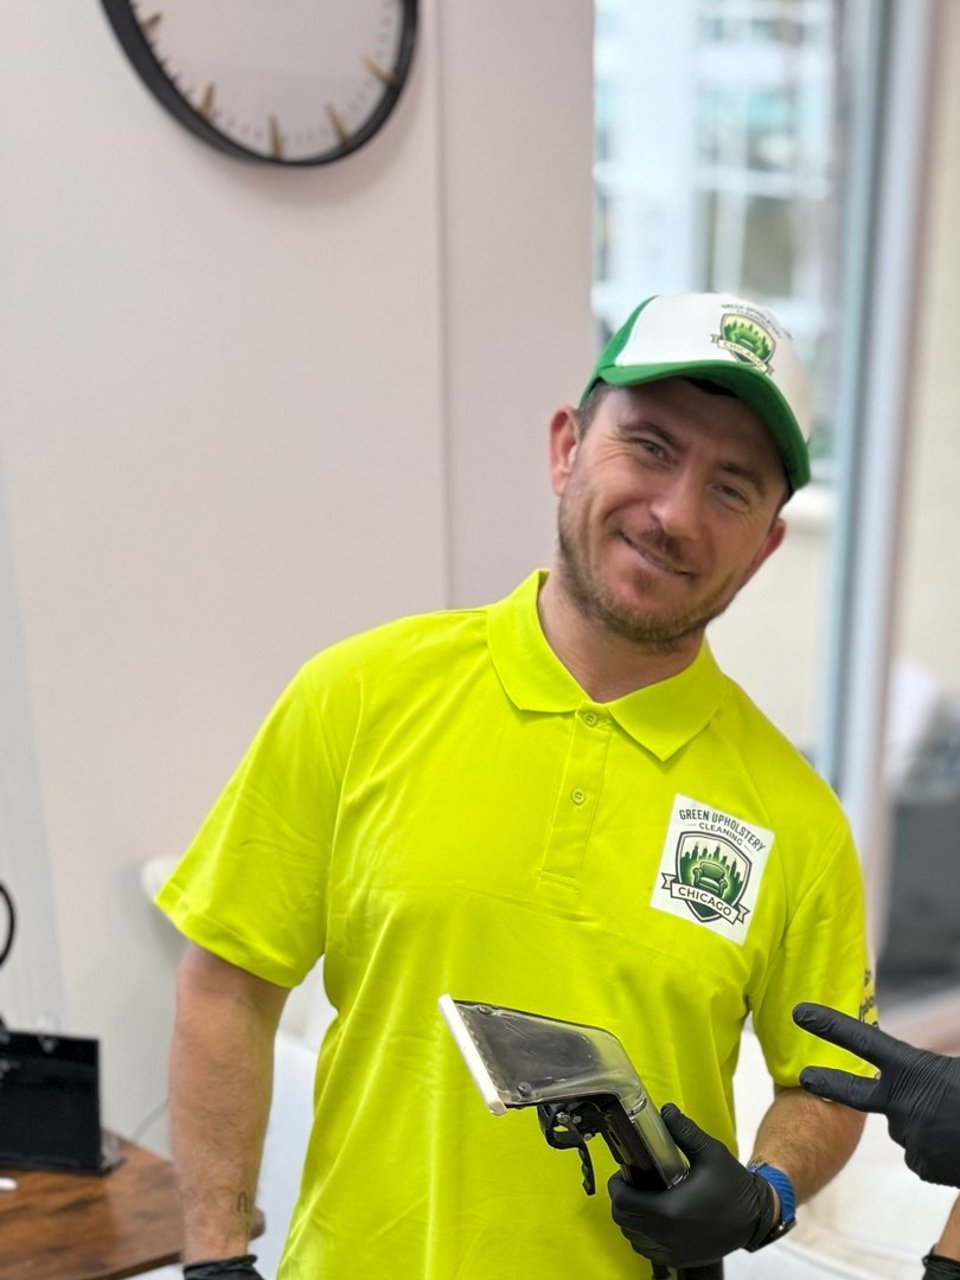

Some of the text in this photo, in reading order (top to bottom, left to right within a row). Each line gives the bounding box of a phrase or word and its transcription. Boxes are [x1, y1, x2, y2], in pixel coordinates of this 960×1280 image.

[679, 808, 766, 852] GREEN UPHOLSTERY
[698, 822, 744, 846] CLEANING
[677, 886, 733, 917] CHICAGO
